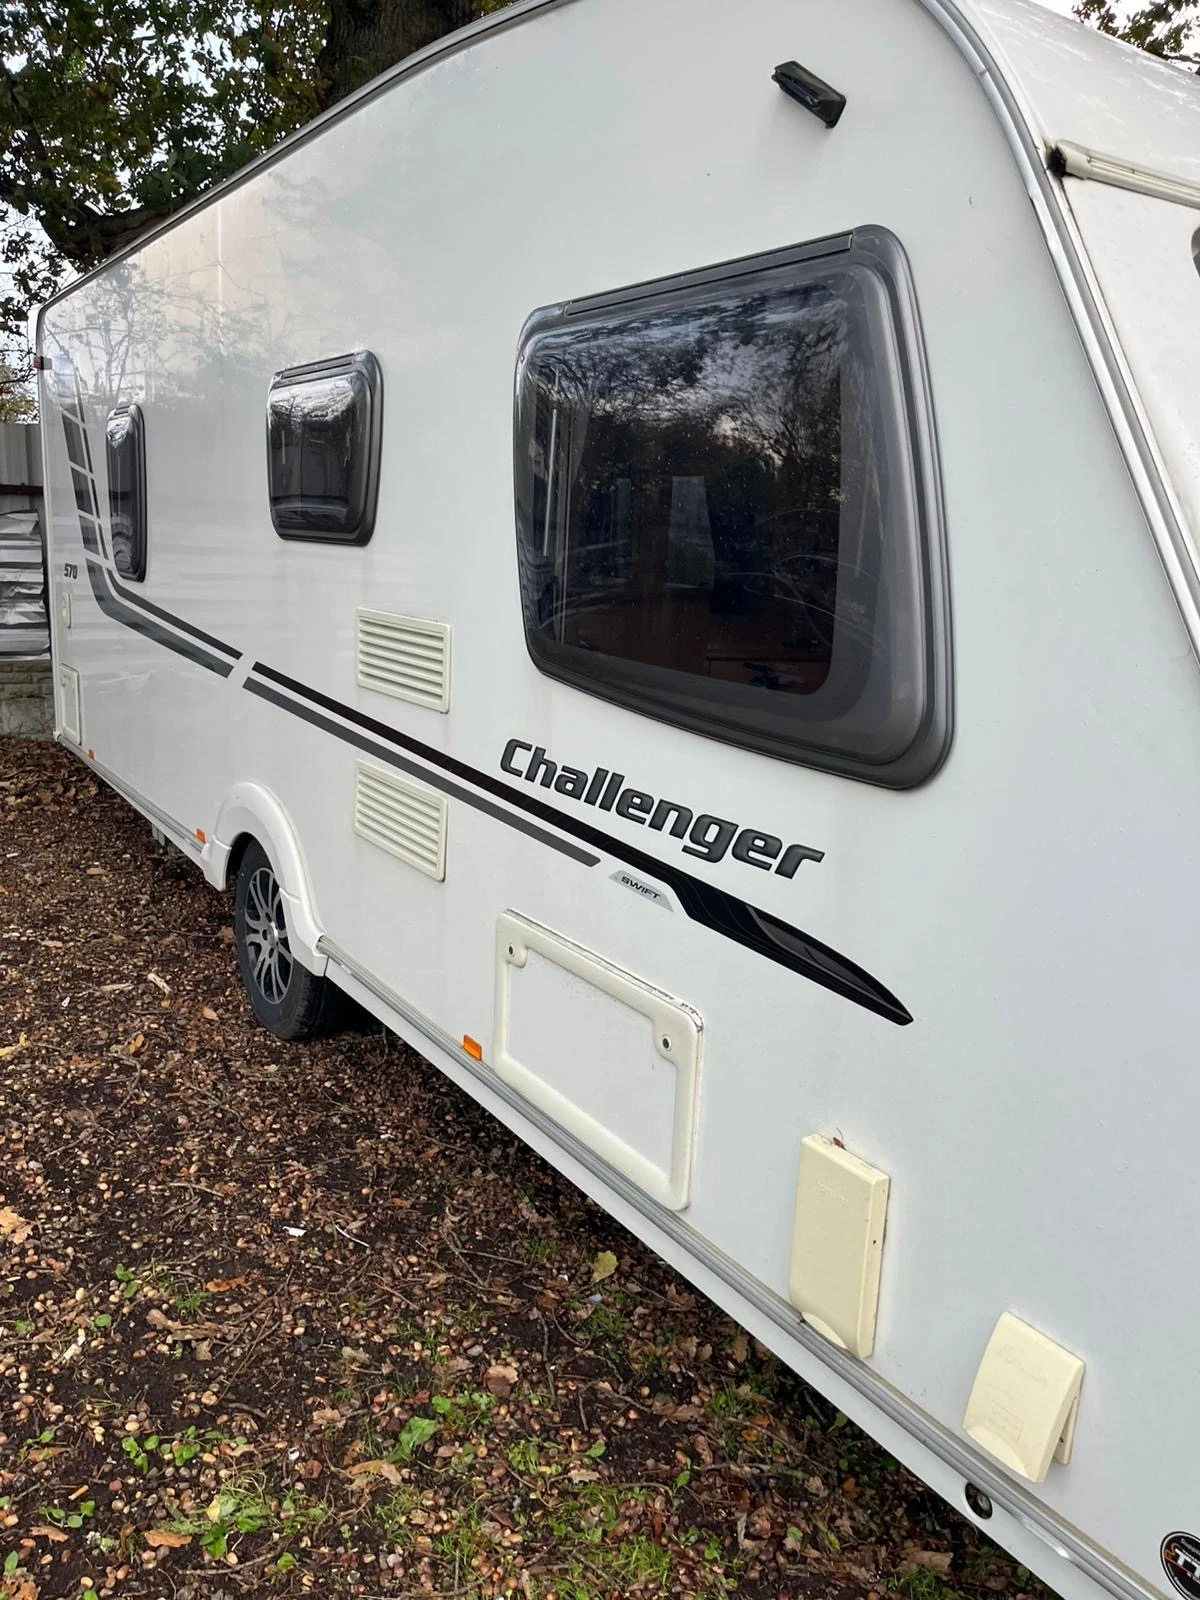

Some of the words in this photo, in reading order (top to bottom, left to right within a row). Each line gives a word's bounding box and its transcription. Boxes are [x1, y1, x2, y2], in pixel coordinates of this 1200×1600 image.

[64, 563, 78, 579] 570
[499, 738, 826, 880] Challenger
[620, 876, 661, 899] SWIFT
